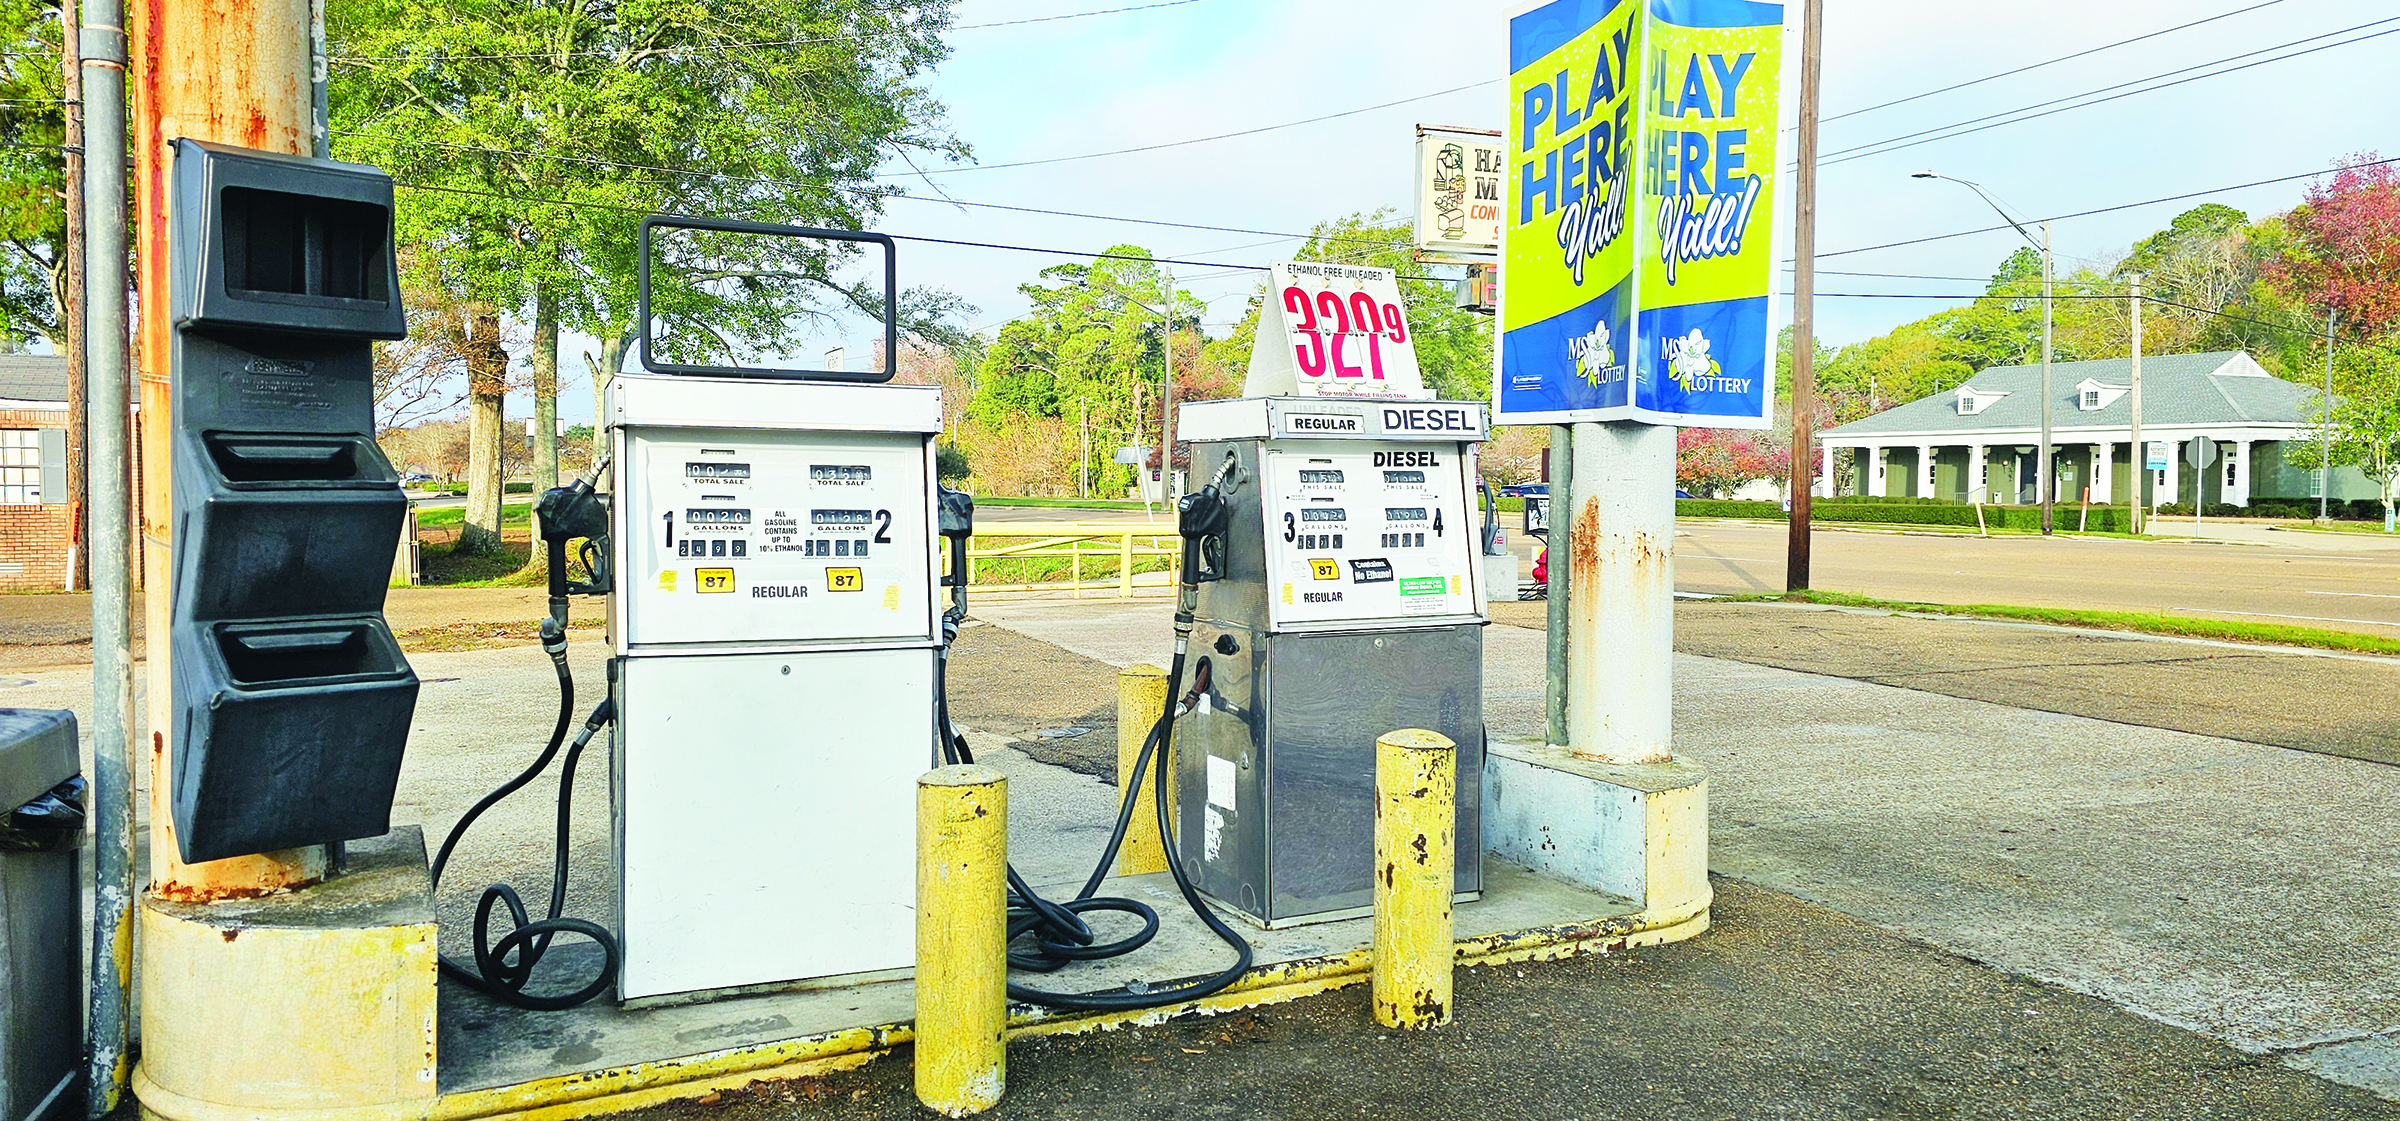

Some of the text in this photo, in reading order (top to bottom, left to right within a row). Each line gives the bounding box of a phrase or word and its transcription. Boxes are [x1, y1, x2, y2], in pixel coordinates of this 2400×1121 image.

[1524, 9, 1636, 152] PLAY
[1649, 43, 1756, 118] PLAY
[1521, 95, 1629, 225] HERE
[1646, 126, 1747, 195] HERE
[1557, 140, 1633, 286] Y'all!
[1657, 174, 1762, 286] Y'all!
[1287, 264, 1383, 281] ETHANOL FREE UNLEADED
[1597, 364, 1626, 385] LOTTERY
[1690, 377, 1752, 394] LOTTERY
[1295, 418, 1356, 430] REGULAR
[1384, 409, 1476, 431] DIESEL
[1373, 451, 1440, 467] DIESEL
[663, 511, 673, 548] 1
[874, 509, 892, 544] 2
[1284, 512, 1295, 543] 3
[1433, 508, 1444, 537] 4
[836, 575, 855, 587] 87
[1319, 566, 1333, 575] 87
[1354, 569, 1392, 580] No Ethanol
[705, 576, 726, 588] 87
[752, 586, 808, 599] REGULAR
[1304, 592, 1343, 603] REGULAR
